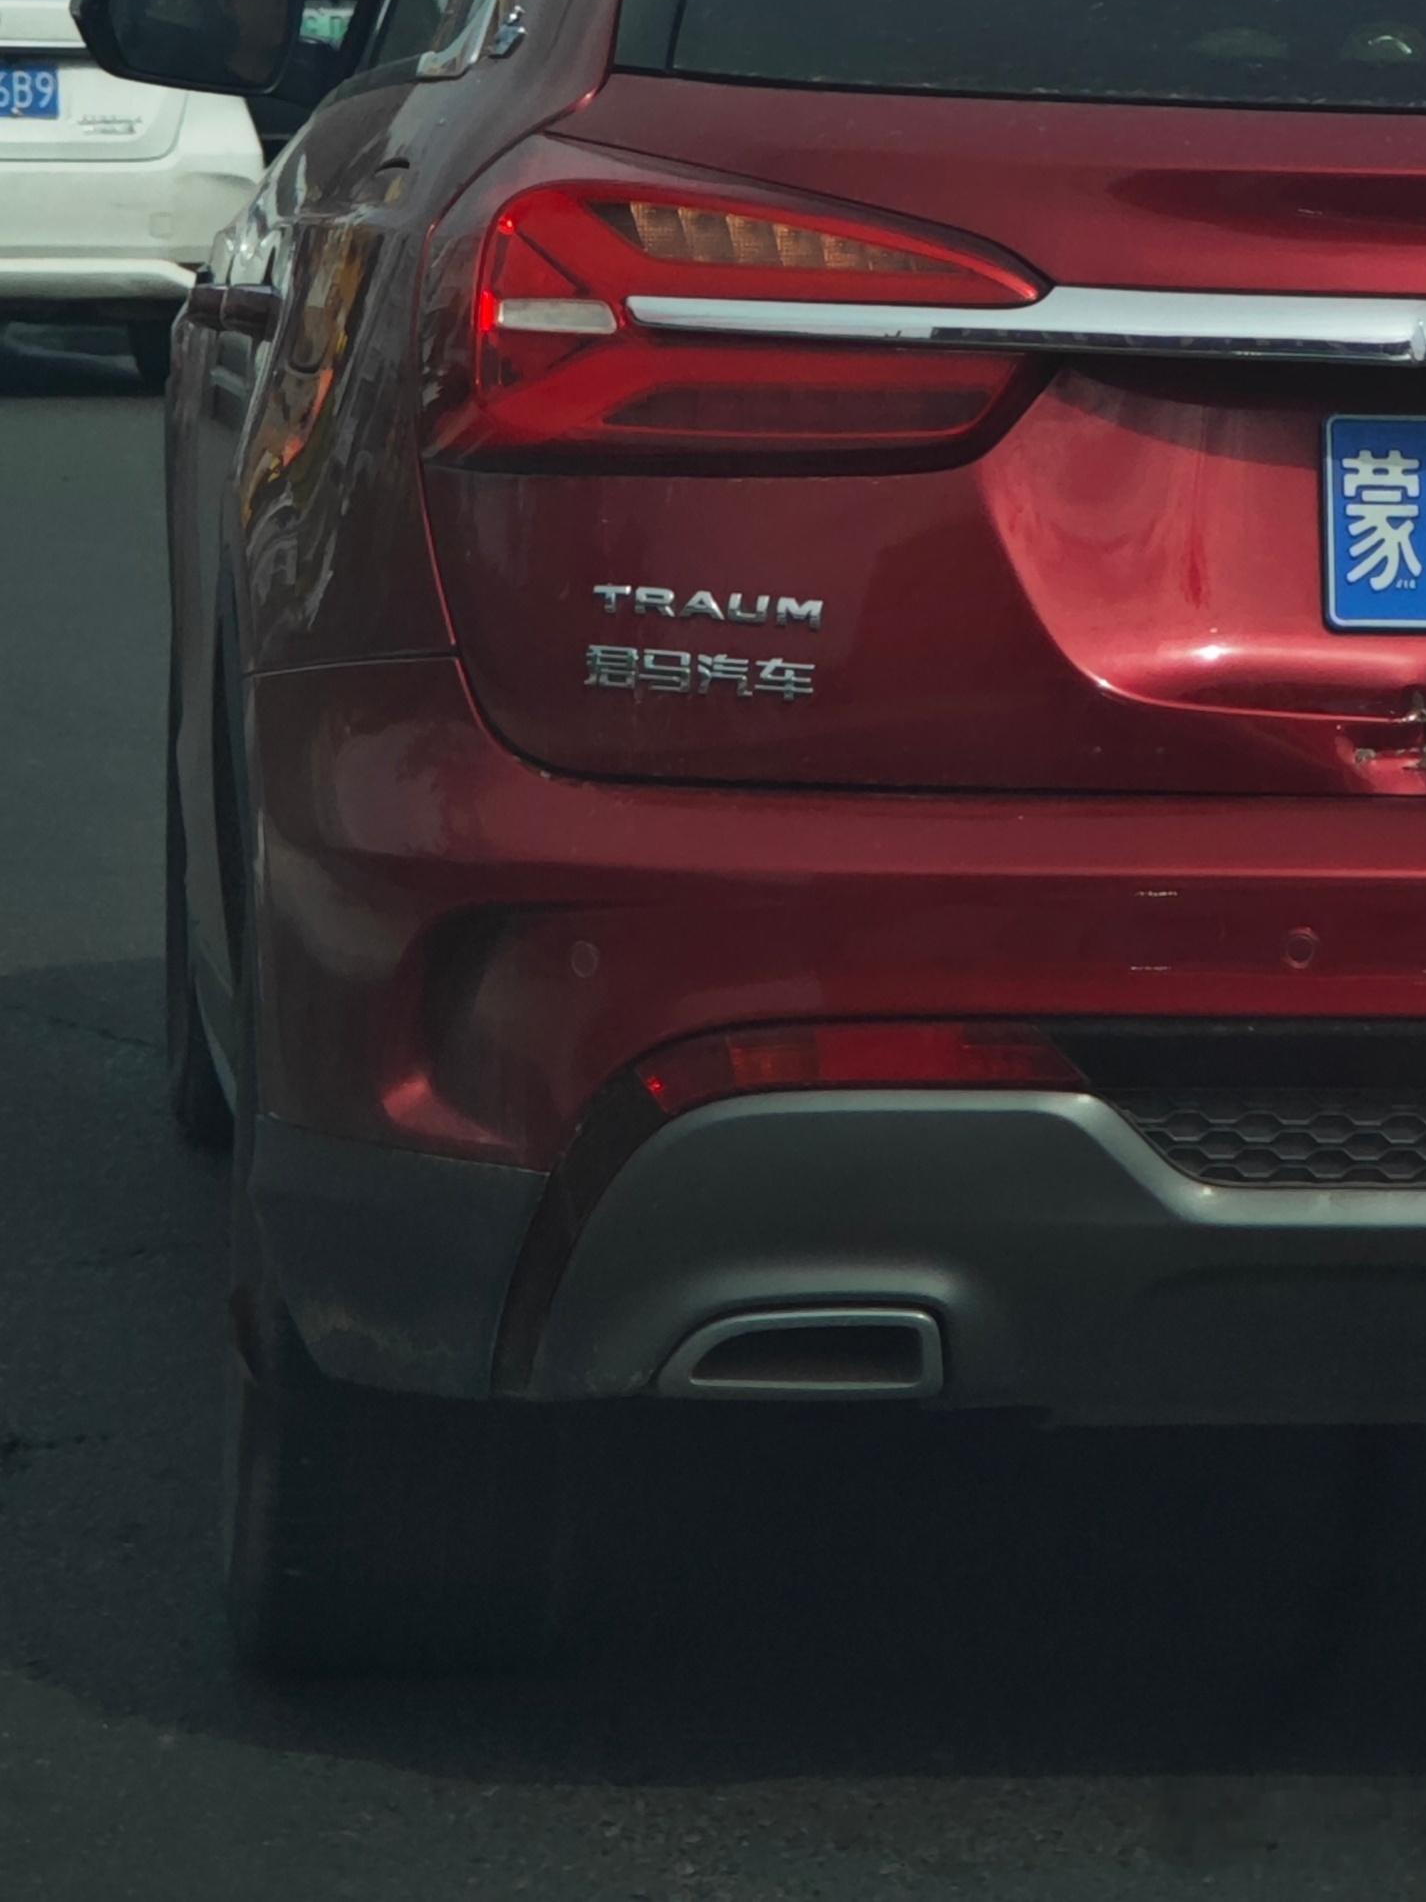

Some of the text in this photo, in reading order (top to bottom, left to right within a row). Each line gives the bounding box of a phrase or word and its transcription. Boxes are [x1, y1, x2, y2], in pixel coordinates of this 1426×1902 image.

[593, 584, 823, 629] TRAUM
[584, 644, 815, 700] 君马汽车
